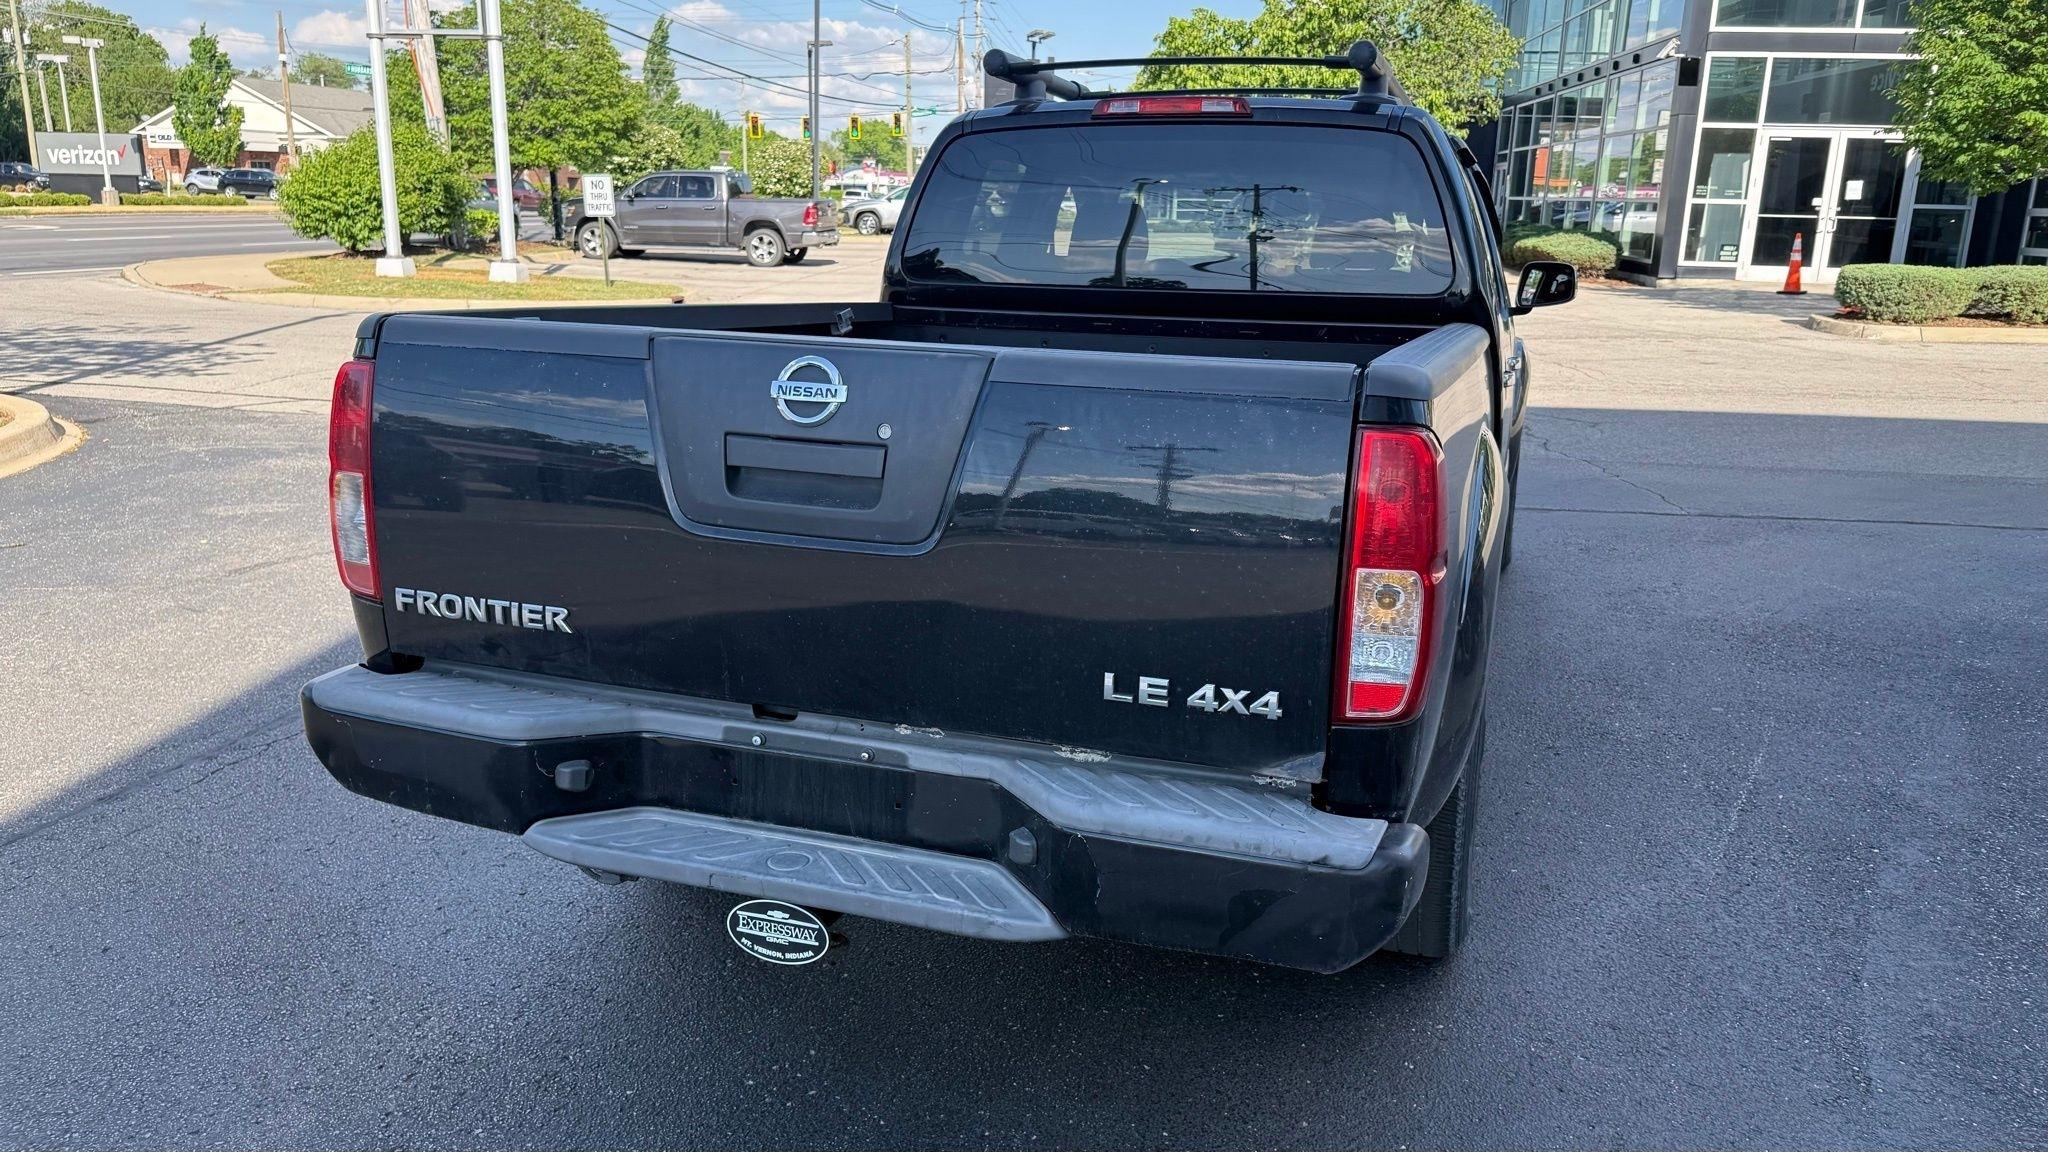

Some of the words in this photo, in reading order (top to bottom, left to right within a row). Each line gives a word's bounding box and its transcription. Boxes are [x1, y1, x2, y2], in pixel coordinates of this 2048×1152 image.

[46, 144, 120, 166] verizon
[591, 180, 605, 190] NO
[590, 192, 608, 201] THRU
[588, 203, 613, 212] TRAFFIC
[777, 384, 838, 399] NISSAN
[394, 587, 573, 635] FRONTIER
[1103, 672, 1170, 708] LE
[738, 914, 818, 942] EXPRESSWAY
[740, 937, 754, 949] MT.
[753, 945, 785, 960] VERNON,
[784, 950, 815, 960] INDIANA
[765, 936, 790, 946] GMC
